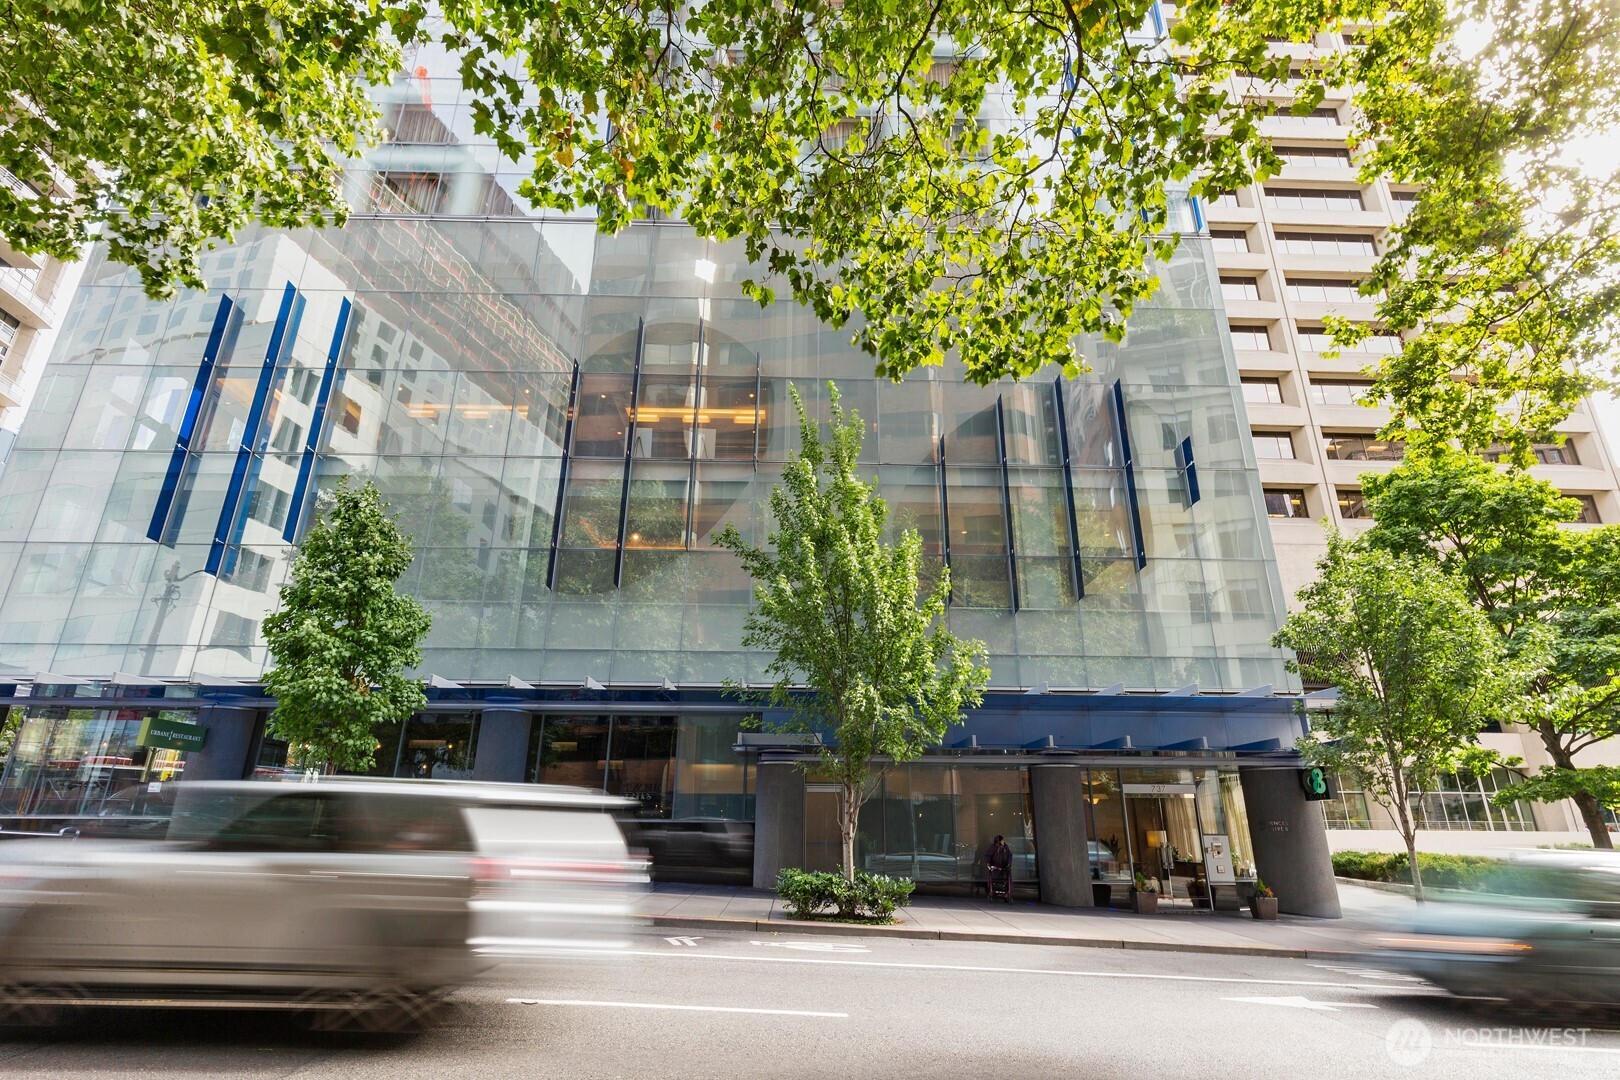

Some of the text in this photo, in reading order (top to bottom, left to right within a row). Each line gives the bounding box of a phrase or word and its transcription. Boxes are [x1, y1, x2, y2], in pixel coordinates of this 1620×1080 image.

[150, 729, 202, 742] URBANE RESTAURANT
[1151, 785, 1167, 793] 737
